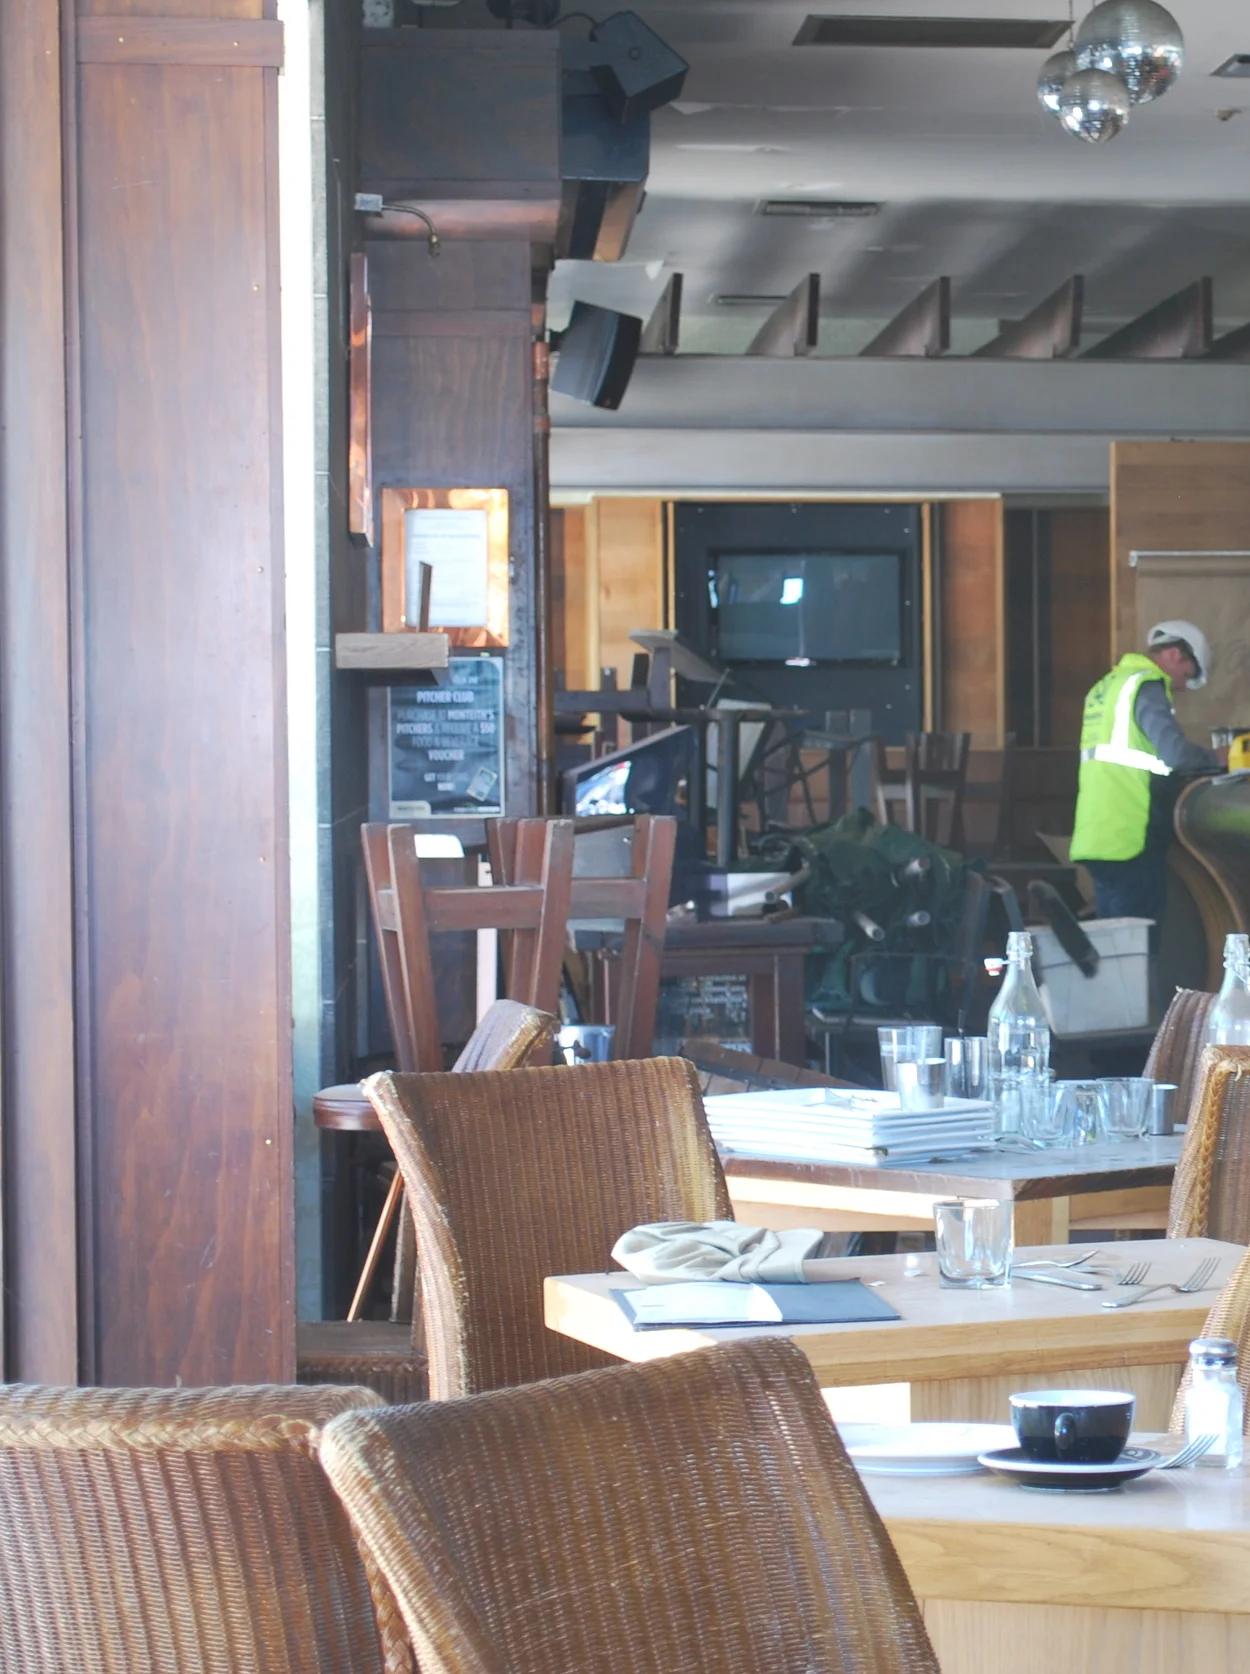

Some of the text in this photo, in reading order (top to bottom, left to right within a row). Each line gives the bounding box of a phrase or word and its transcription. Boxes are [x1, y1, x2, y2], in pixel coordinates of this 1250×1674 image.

[417, 691, 474, 703] PITCHER CLUB
[396, 723, 433, 734] PITCHERS
[428, 750, 464, 761] VOUCHER
